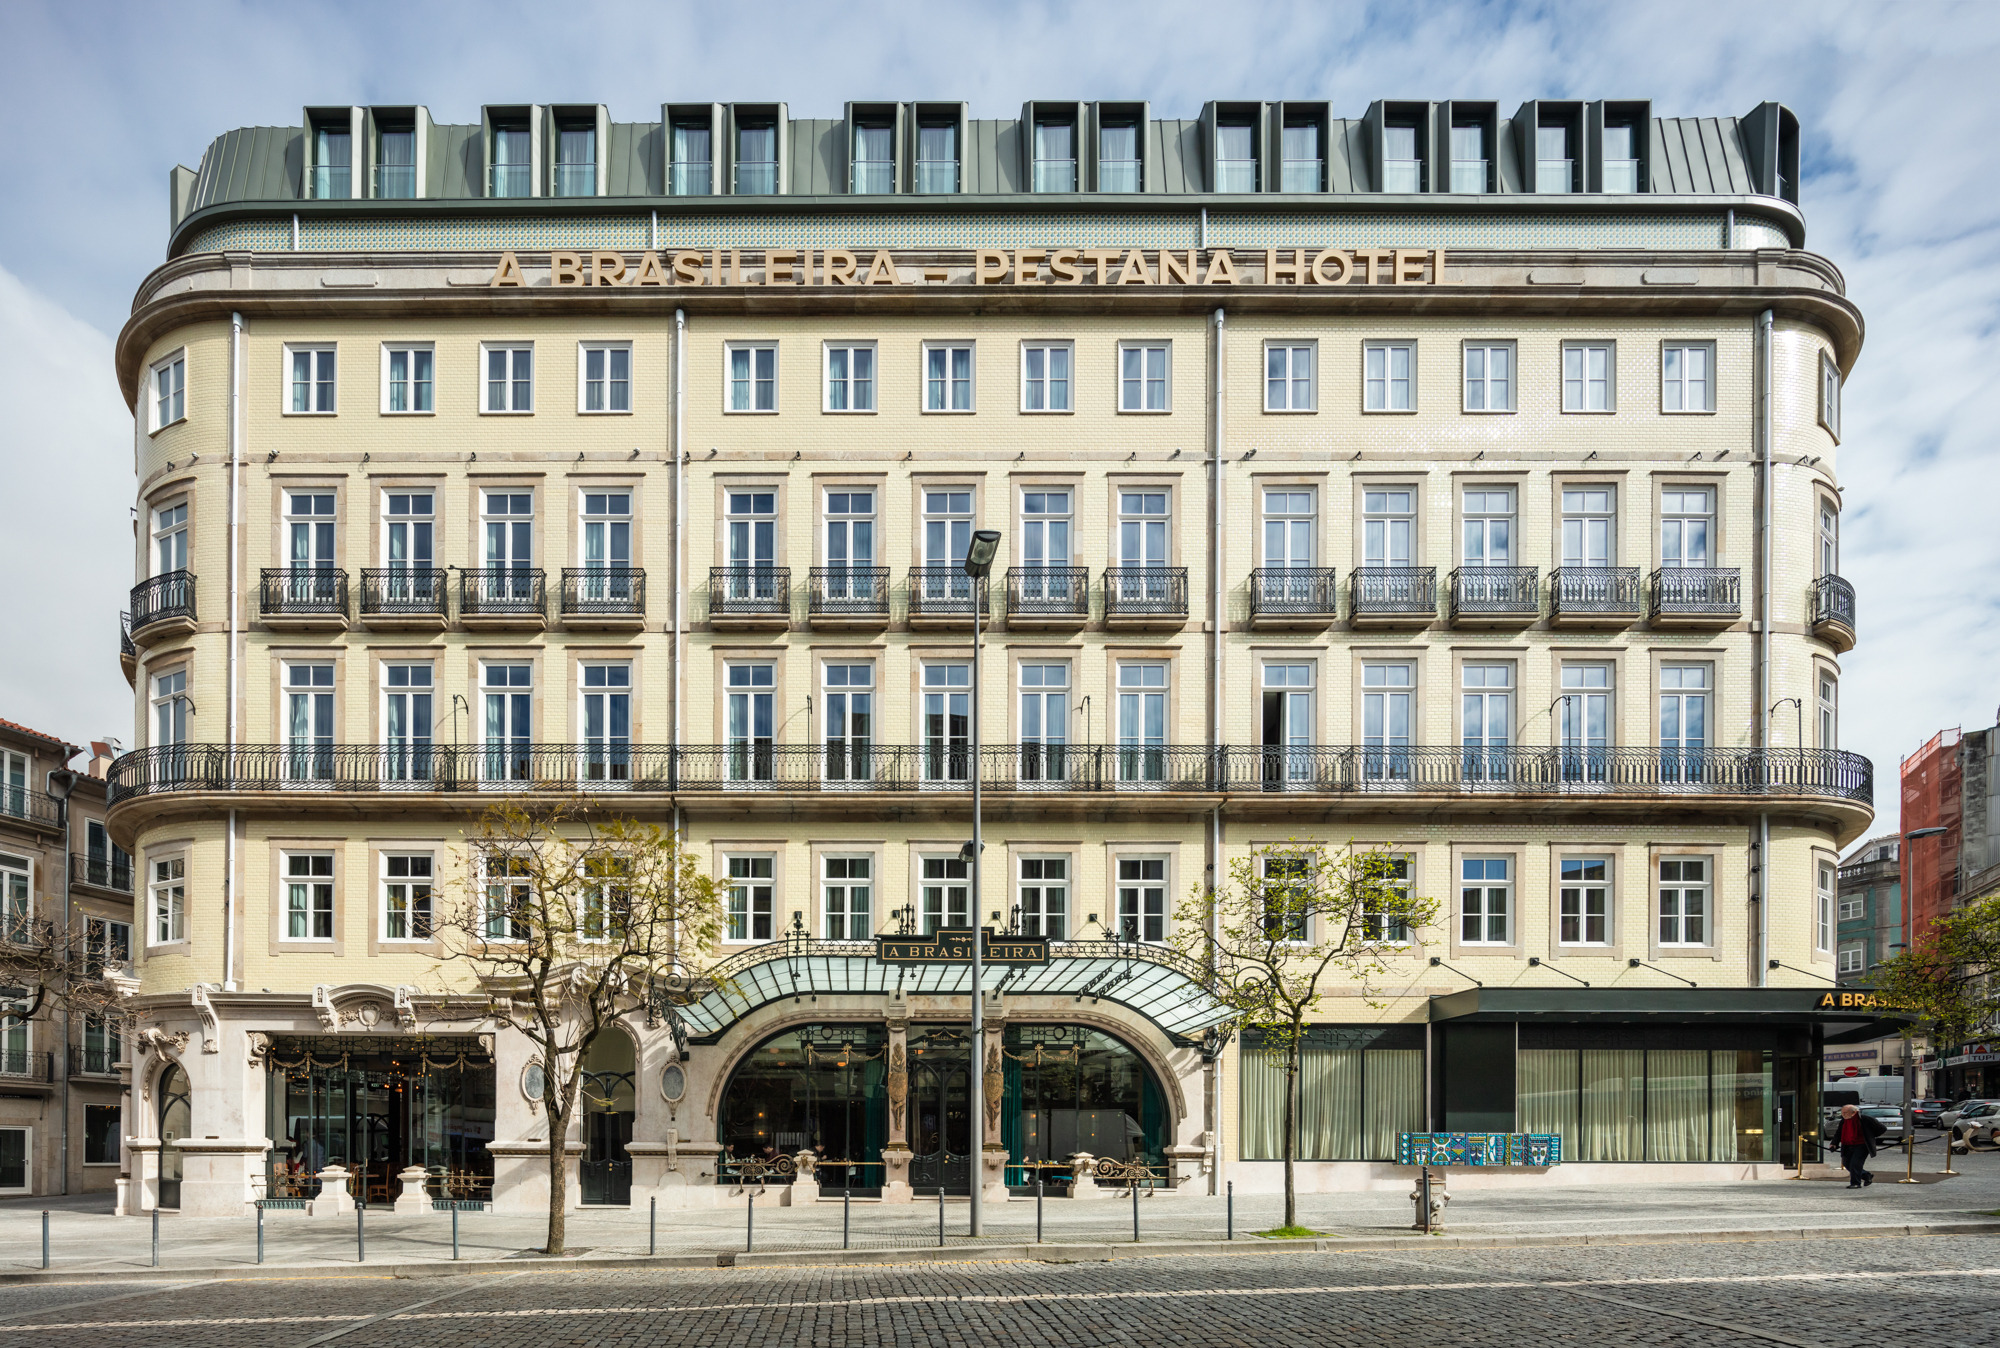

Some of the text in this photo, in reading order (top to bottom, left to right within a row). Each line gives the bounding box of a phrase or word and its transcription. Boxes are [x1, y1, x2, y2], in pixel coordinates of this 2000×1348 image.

[490, 251, 526, 286] A
[551, 249, 901, 286] BRASILEIRA
[975, 249, 1240, 285] PESTANA
[1267, 248, 1464, 285] HOTEL
[889, 946, 899, 957] A
[1821, 992, 1835, 1007] A
